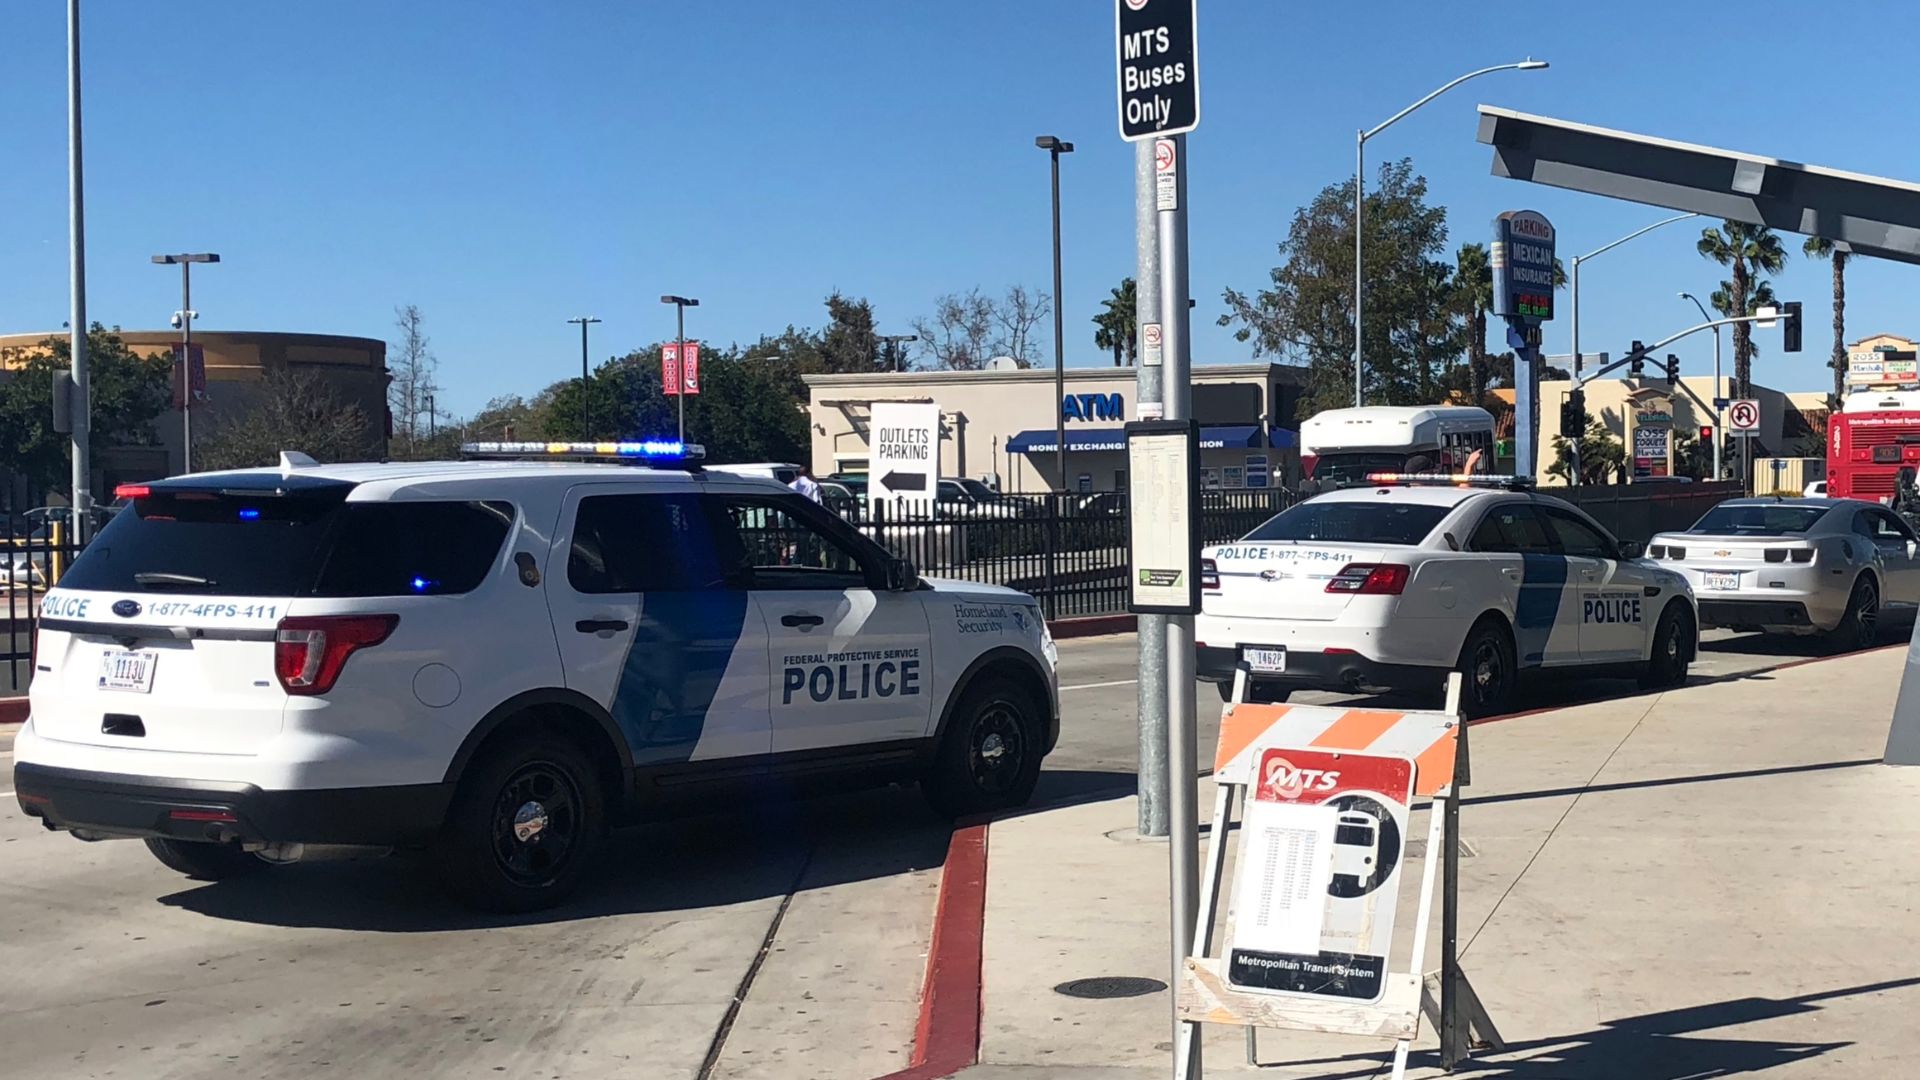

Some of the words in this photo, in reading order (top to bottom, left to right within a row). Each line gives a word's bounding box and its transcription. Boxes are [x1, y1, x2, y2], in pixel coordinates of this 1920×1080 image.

[1124, 26, 1170, 60] MTS
[1125, 62, 1186, 92] Buses
[1126, 94, 1171, 126] Only
[1514, 219, 1549, 238] PARKING
[1513, 242, 1551, 266] MEXICAN
[1513, 267, 1551, 286] INSURANCE
[1853, 353, 1880, 361] ROSS
[1063, 393, 1122, 421] ATM
[880, 427, 928, 444] OUTLETS
[1636, 429, 1666, 438] ROSS
[1636, 438, 1666, 447] COQUETA
[880, 443, 928, 460] PARKING
[1216, 547, 1268, 559] POLICE
[42, 595, 91, 618] POLICE
[149, 602, 276, 619] 1-877-4FPS-411
[953, 604, 1008, 618] Homeland
[1584, 599, 1641, 623] POLICE
[957, 619, 1003, 636] Security
[783, 654, 825, 665] FEDERAL
[827, 650, 882, 662] PROTECTIVE
[884, 648, 919, 659] SERVICE
[1258, 652, 1282, 665] 1462P
[782, 660, 920, 705] POLICE
[1265, 767, 1341, 791] MTS
[1238, 955, 1300, 970] Metropolitan
[1302, 961, 1336, 974] Transit
[1336, 964, 1375, 978] System
